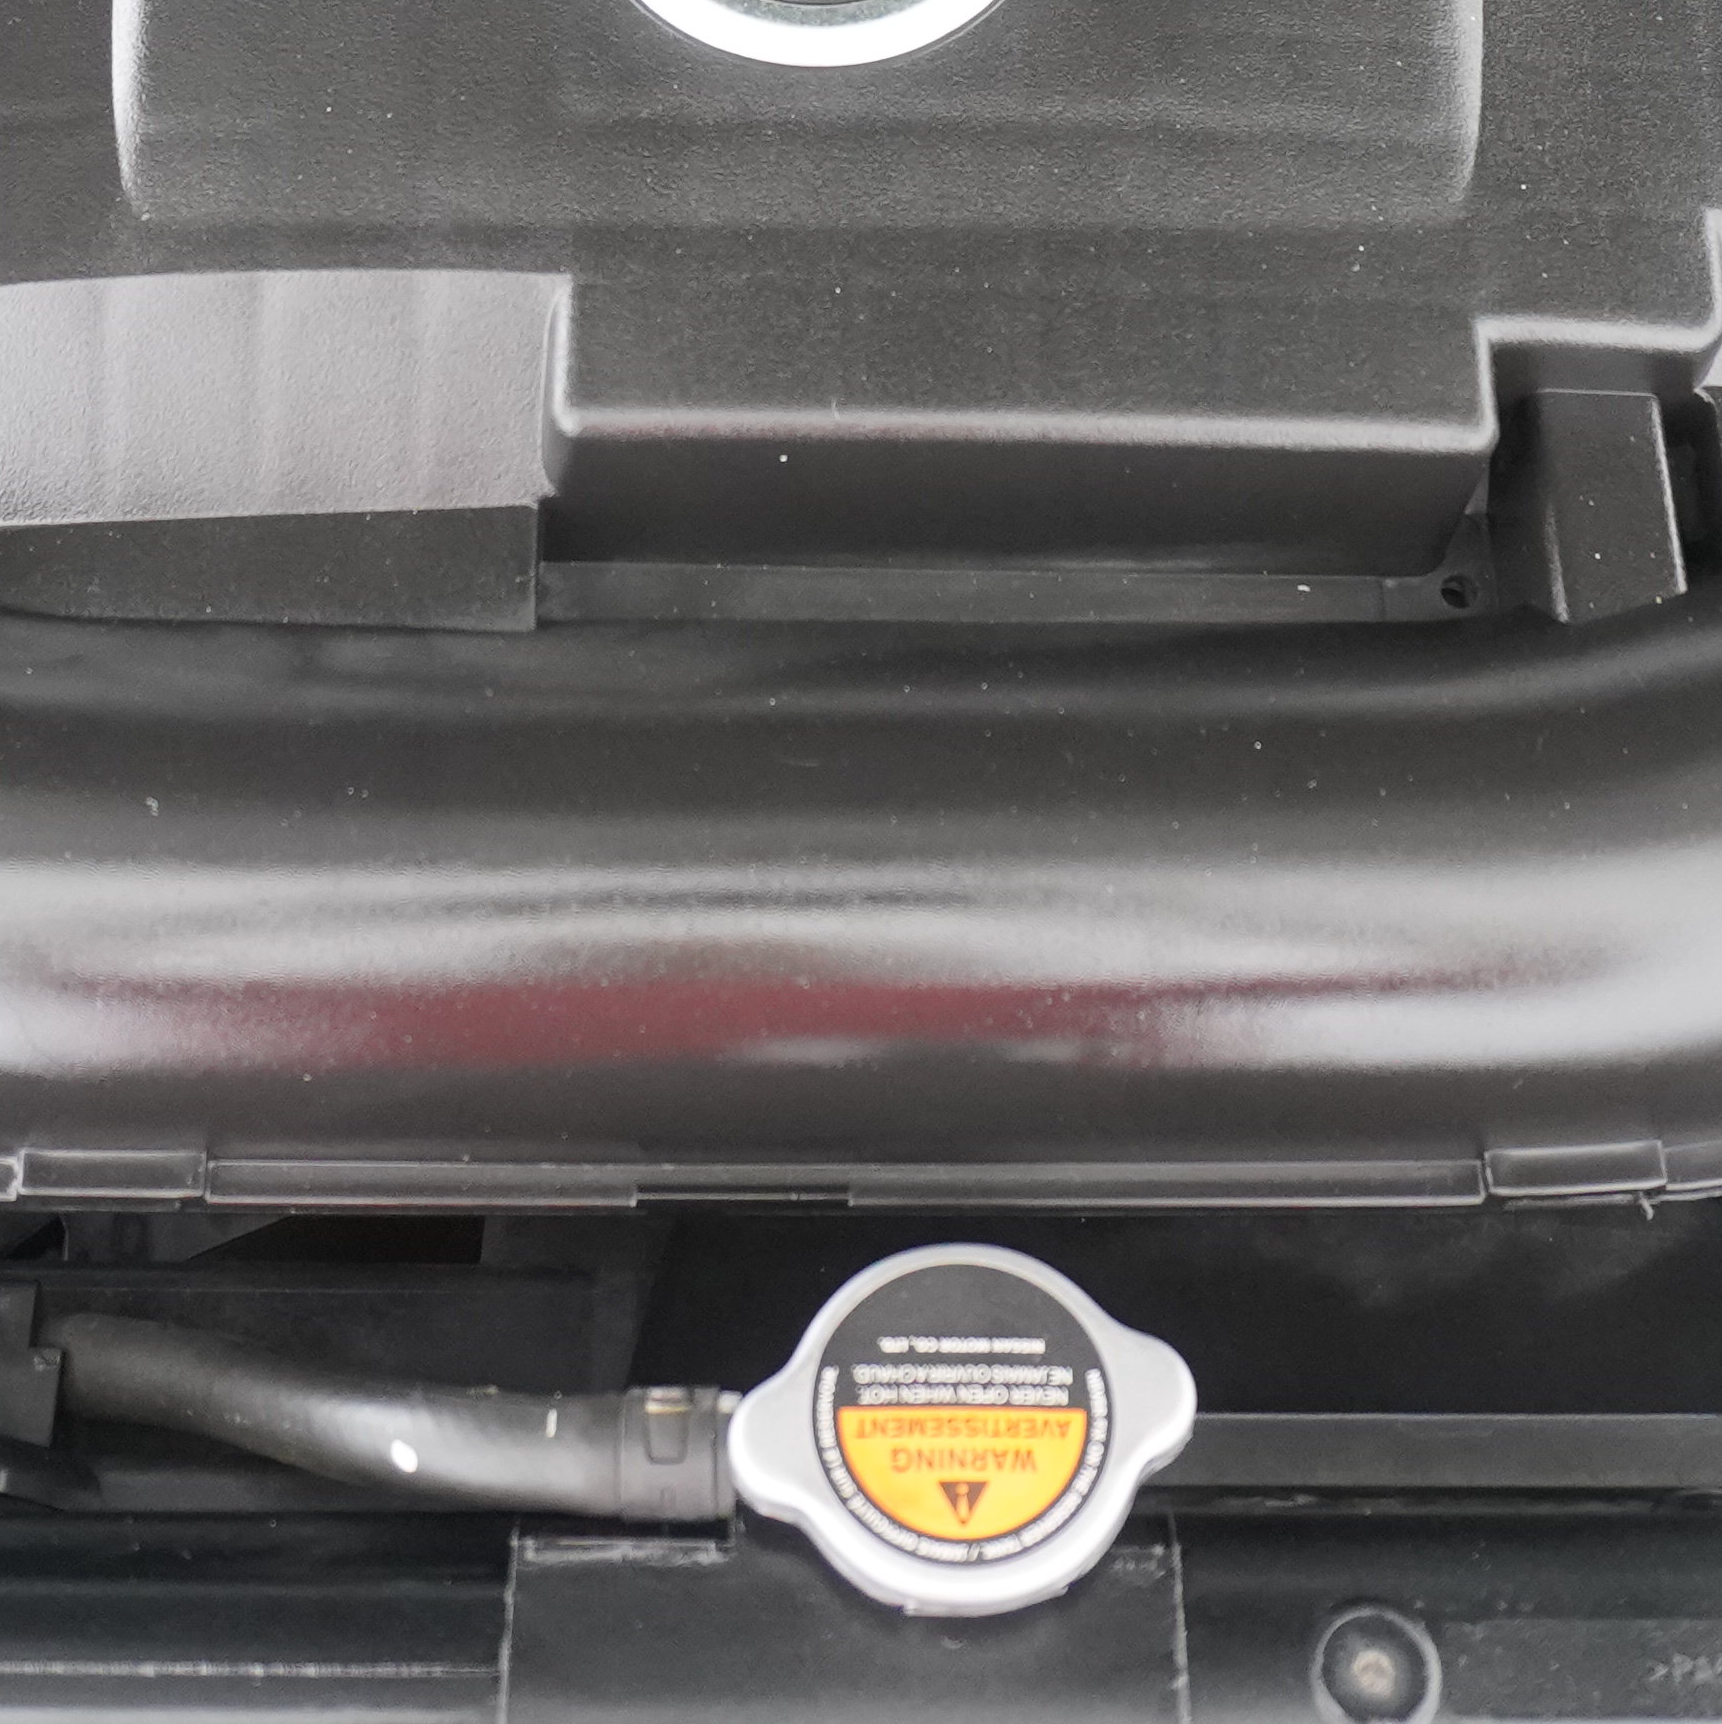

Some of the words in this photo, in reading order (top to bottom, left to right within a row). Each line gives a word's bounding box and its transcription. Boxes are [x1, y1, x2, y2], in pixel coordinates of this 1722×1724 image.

[898, 1384, 957, 1405] WHEN
[956, 1384, 1010, 1406] OPEN
[1009, 1385, 1069, 1406] NEVER
[856, 1416, 1072, 1440] AVERTISSEMENT
[890, 1445, 1039, 1474] WARNING
